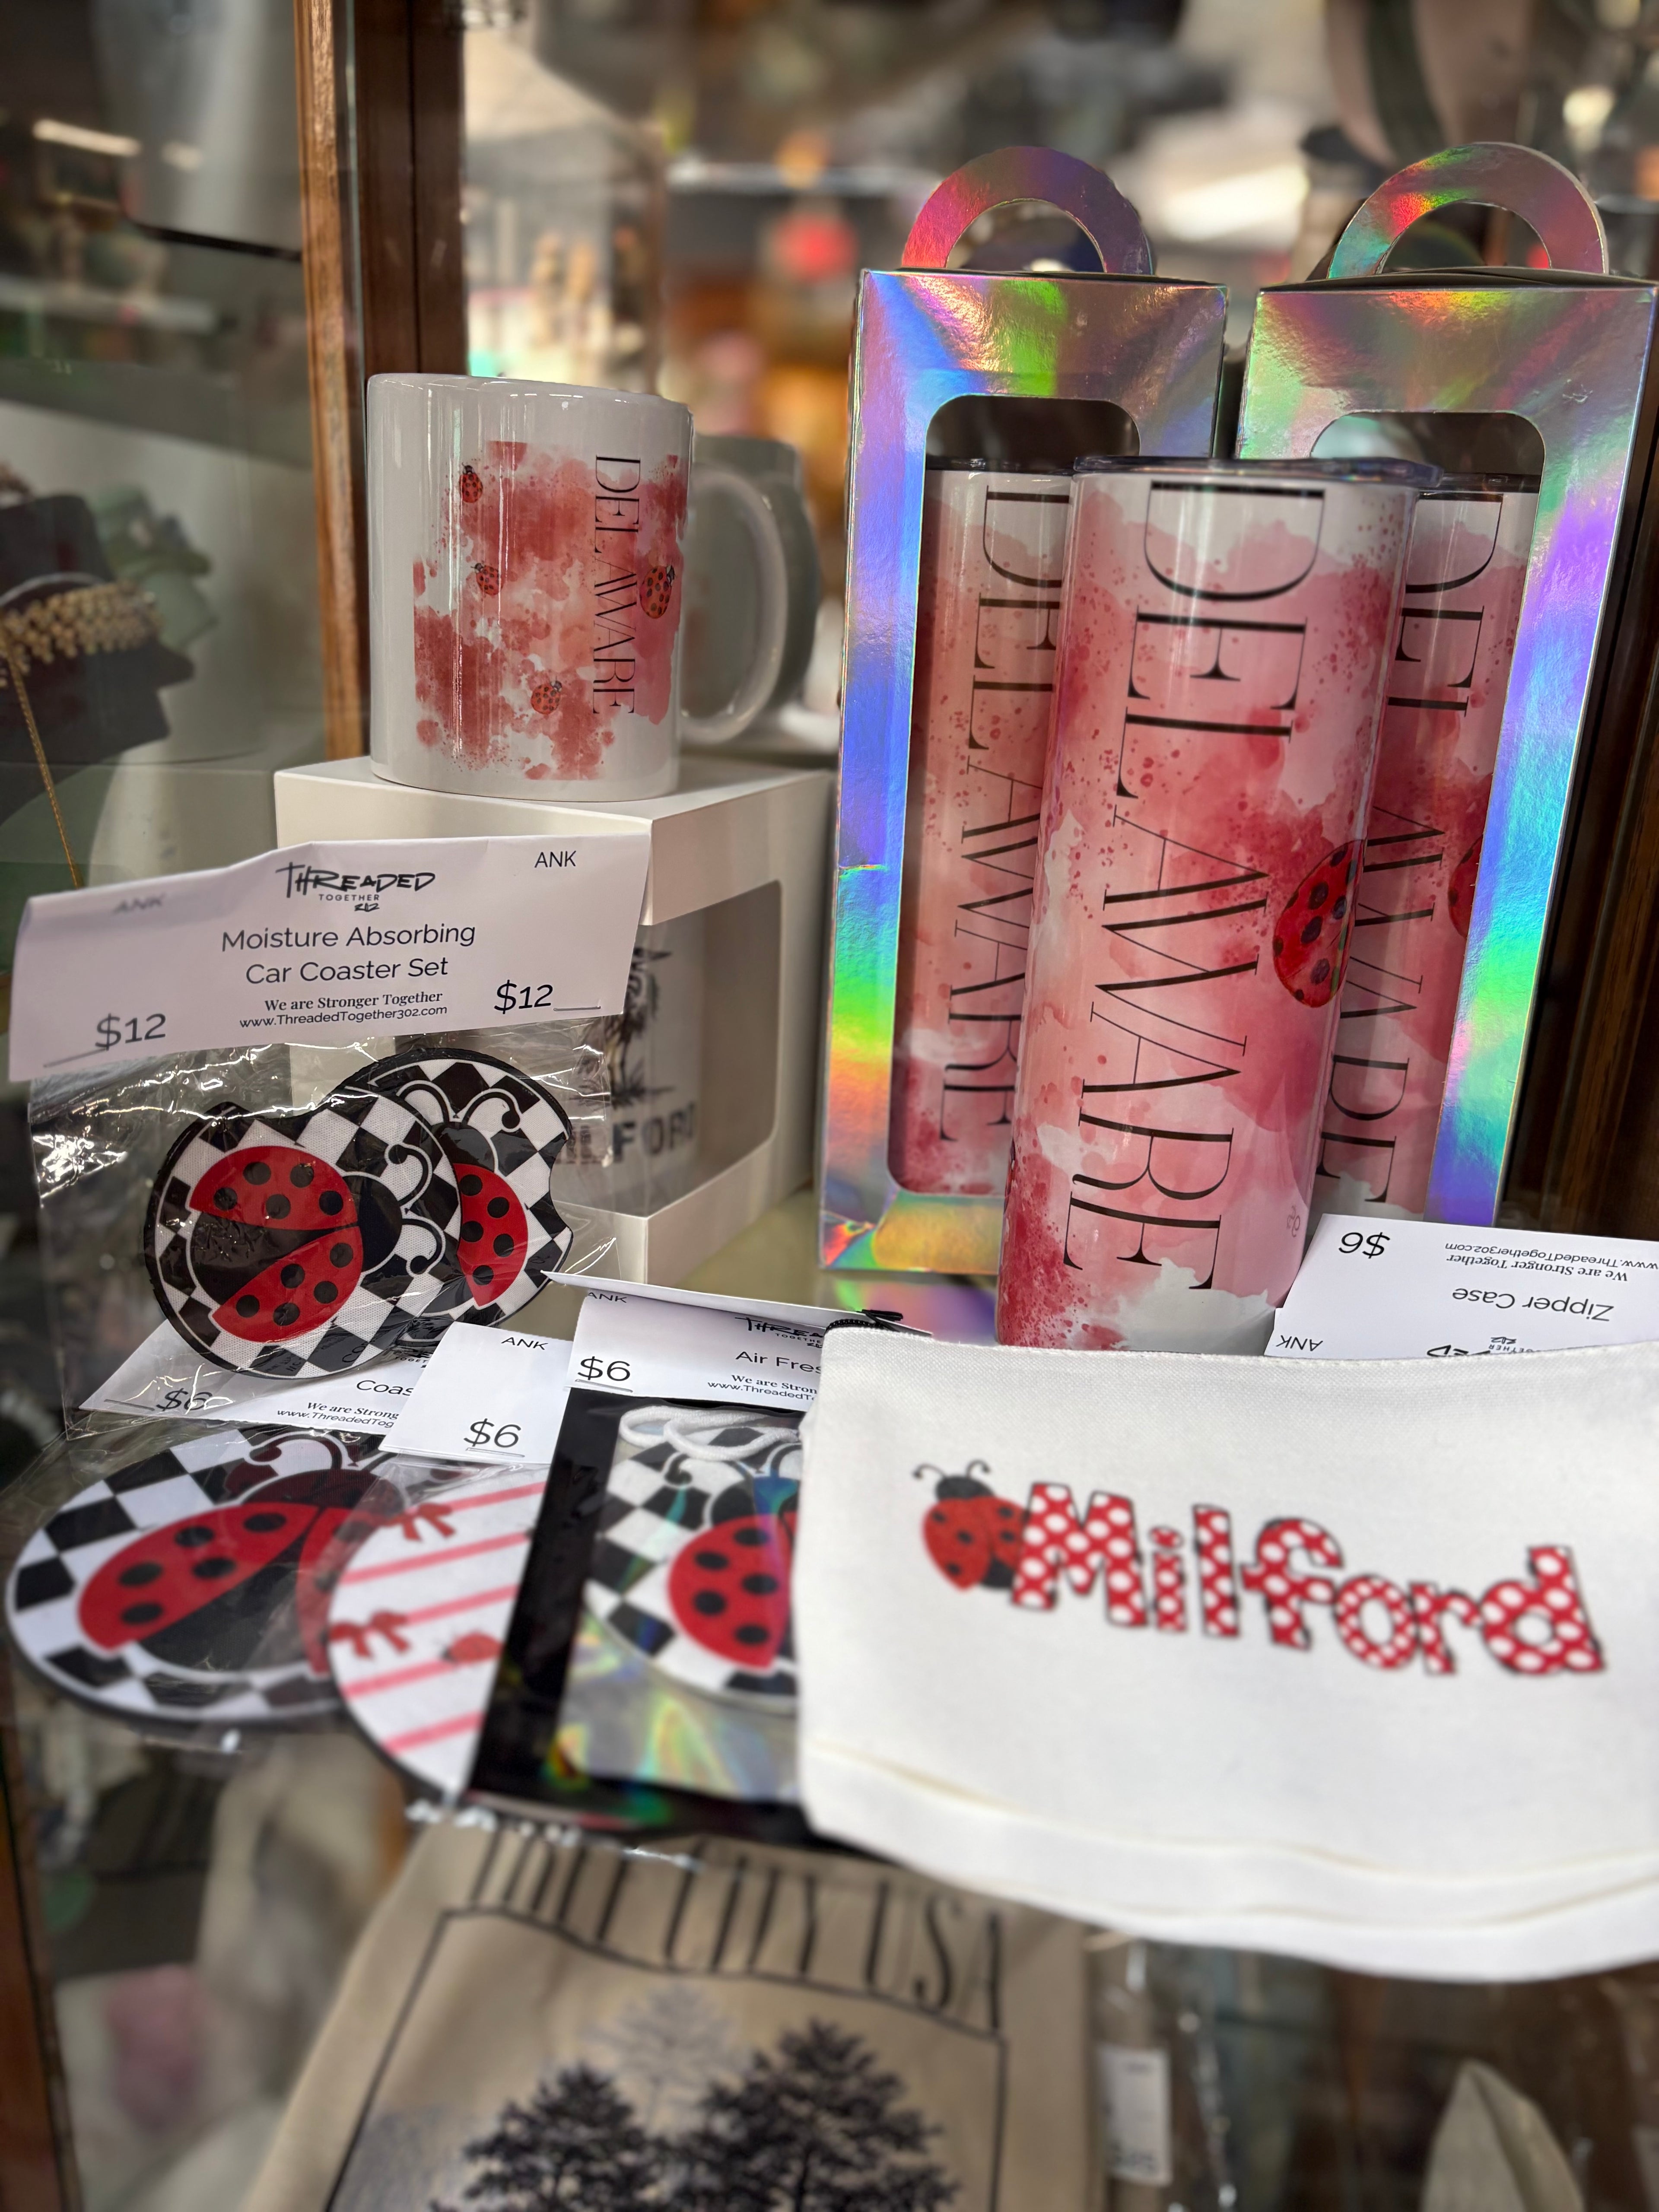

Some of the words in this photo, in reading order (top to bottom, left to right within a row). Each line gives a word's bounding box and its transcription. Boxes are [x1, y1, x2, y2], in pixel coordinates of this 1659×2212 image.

[592, 454, 641, 715] DELAWARE
[534, 851, 577, 868] ANK
[275, 861, 435, 899] THREADED
[1063, 480, 1325, 1292] DELAWARE
[318, 893, 380, 902] TOGETHER
[222, 927, 338, 952] Moisture
[346, 923, 476, 947] Absorbing
[246, 963, 292, 984] Car
[299, 960, 401, 982] Coaster
[407, 957, 448, 977] Set
[264, 998, 287, 1011] We
[291, 998, 314, 1010] are
[318, 997, 379, 1012] Stronger
[382, 992, 443, 1009] Together
[494, 979, 554, 1015] $12
[239, 1006, 448, 1028] www.ThreadedTogether302.com
[95, 1013, 167, 1051] $12
[1338, 1232, 1391, 1259] $6
[1445, 1243, 1658, 1270] www.ThreadedTogether302.com
[1446, 1253, 1508, 1269] Together
[1511, 1260, 1573, 1276] Stronger
[1577, 1267, 1602, 1278] are
[1605, 1270, 1628, 1282] We
[588, 1292, 628, 1304] ANK
[1452, 1288, 1516, 1309] Case
[1521, 1296, 1615, 1322] Zipper
[501, 1337, 549, 1351] ANK
[1276, 1335, 1323, 1352] ANK
[735, 1351, 769, 1364] Air
[578, 1356, 630, 1382] $6
[731, 1374, 753, 1384] We
[756, 1378, 778, 1388] are
[782, 1382, 817, 1395] Stron
[156, 1387, 214, 1413] $6
[307, 1402, 327, 1411] We
[354, 1408, 399, 1420] Strong
[464, 1418, 521, 1448] $6
[1010, 1481, 1607, 1676] Milford
